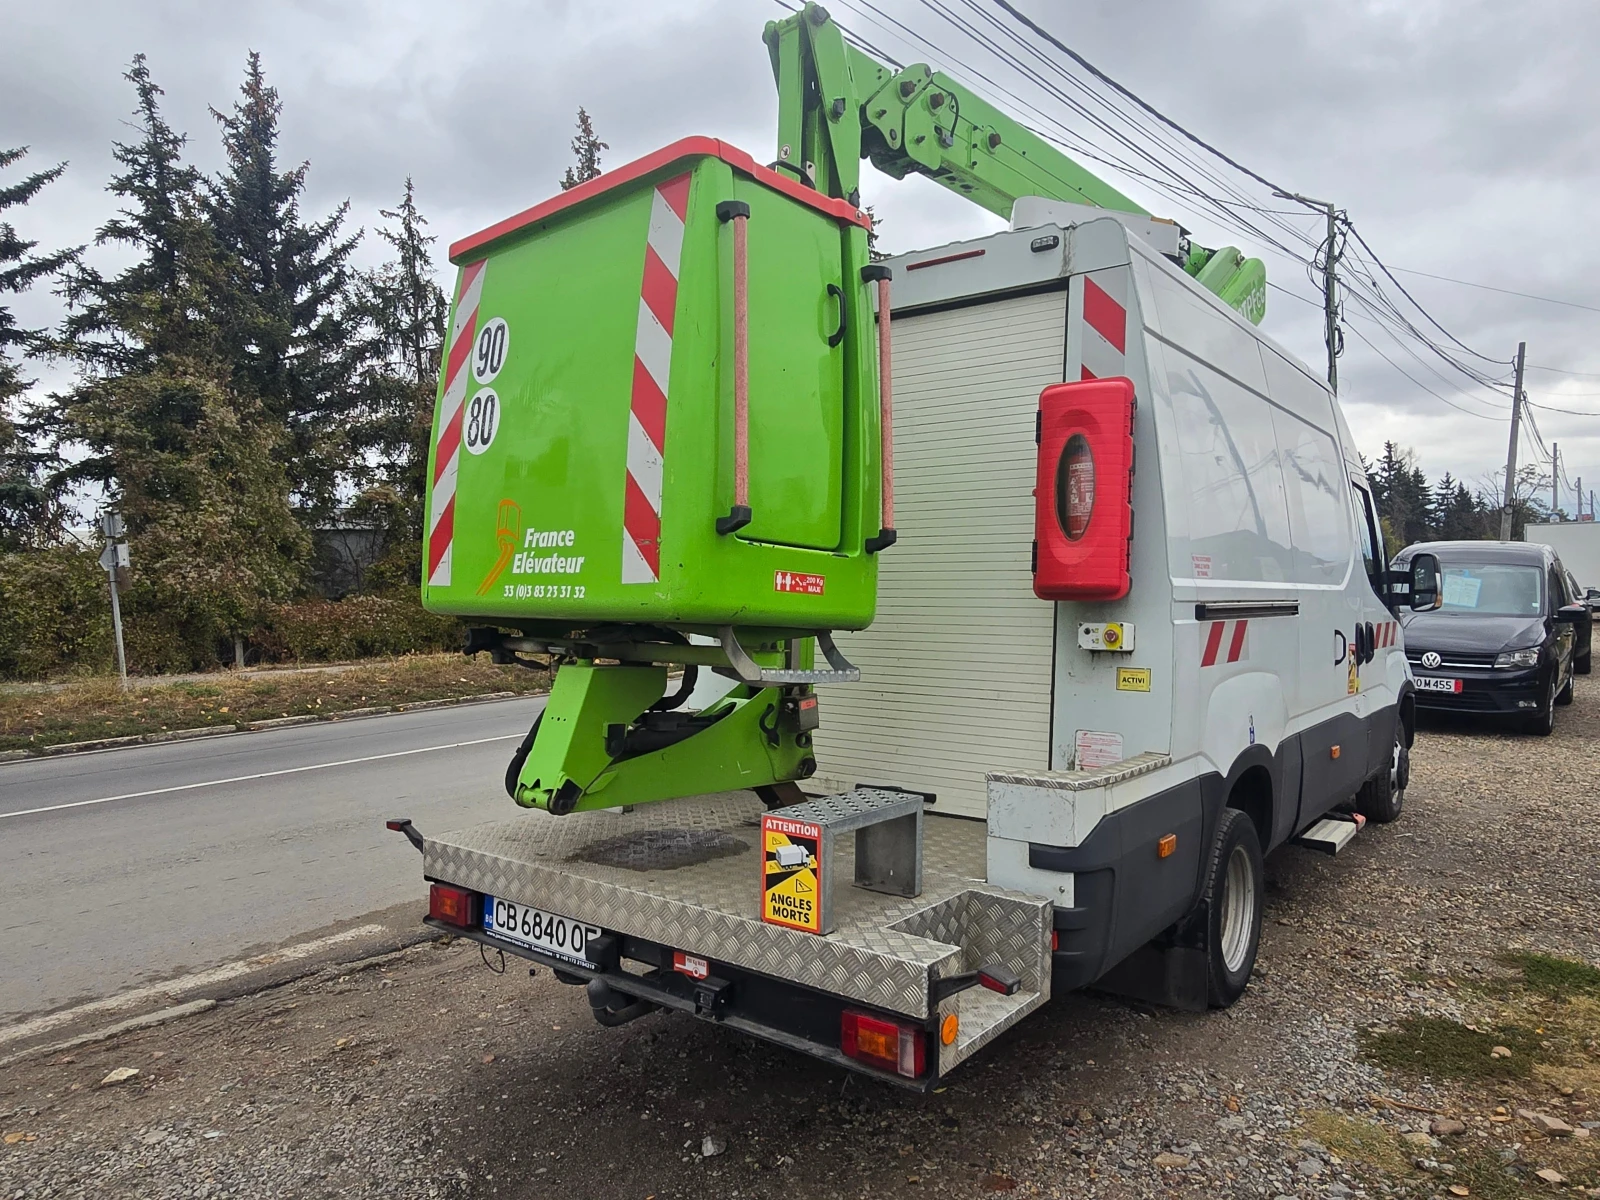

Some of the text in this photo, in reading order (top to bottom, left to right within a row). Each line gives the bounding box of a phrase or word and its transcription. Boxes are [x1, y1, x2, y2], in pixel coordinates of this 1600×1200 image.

[476, 322, 506, 377] 90
[467, 394, 495, 448] 80
[524, 528, 575, 548] France
[512, 551, 585, 574] Elévateur
[504, 585, 514, 598] 33
[534, 585, 545, 598] 83
[546, 585, 558, 598] 23
[559, 585, 571, 598] 31
[573, 585, 585, 599] 32
[1424, 679, 1431, 688] M
[1433, 680, 1452, 690] 455
[765, 818, 819, 837] ATTENTION
[770, 892, 812, 912] ANGLES
[495, 900, 518, 932] CB
[521, 909, 566, 948] 6840
[772, 904, 810, 924] MORTS
